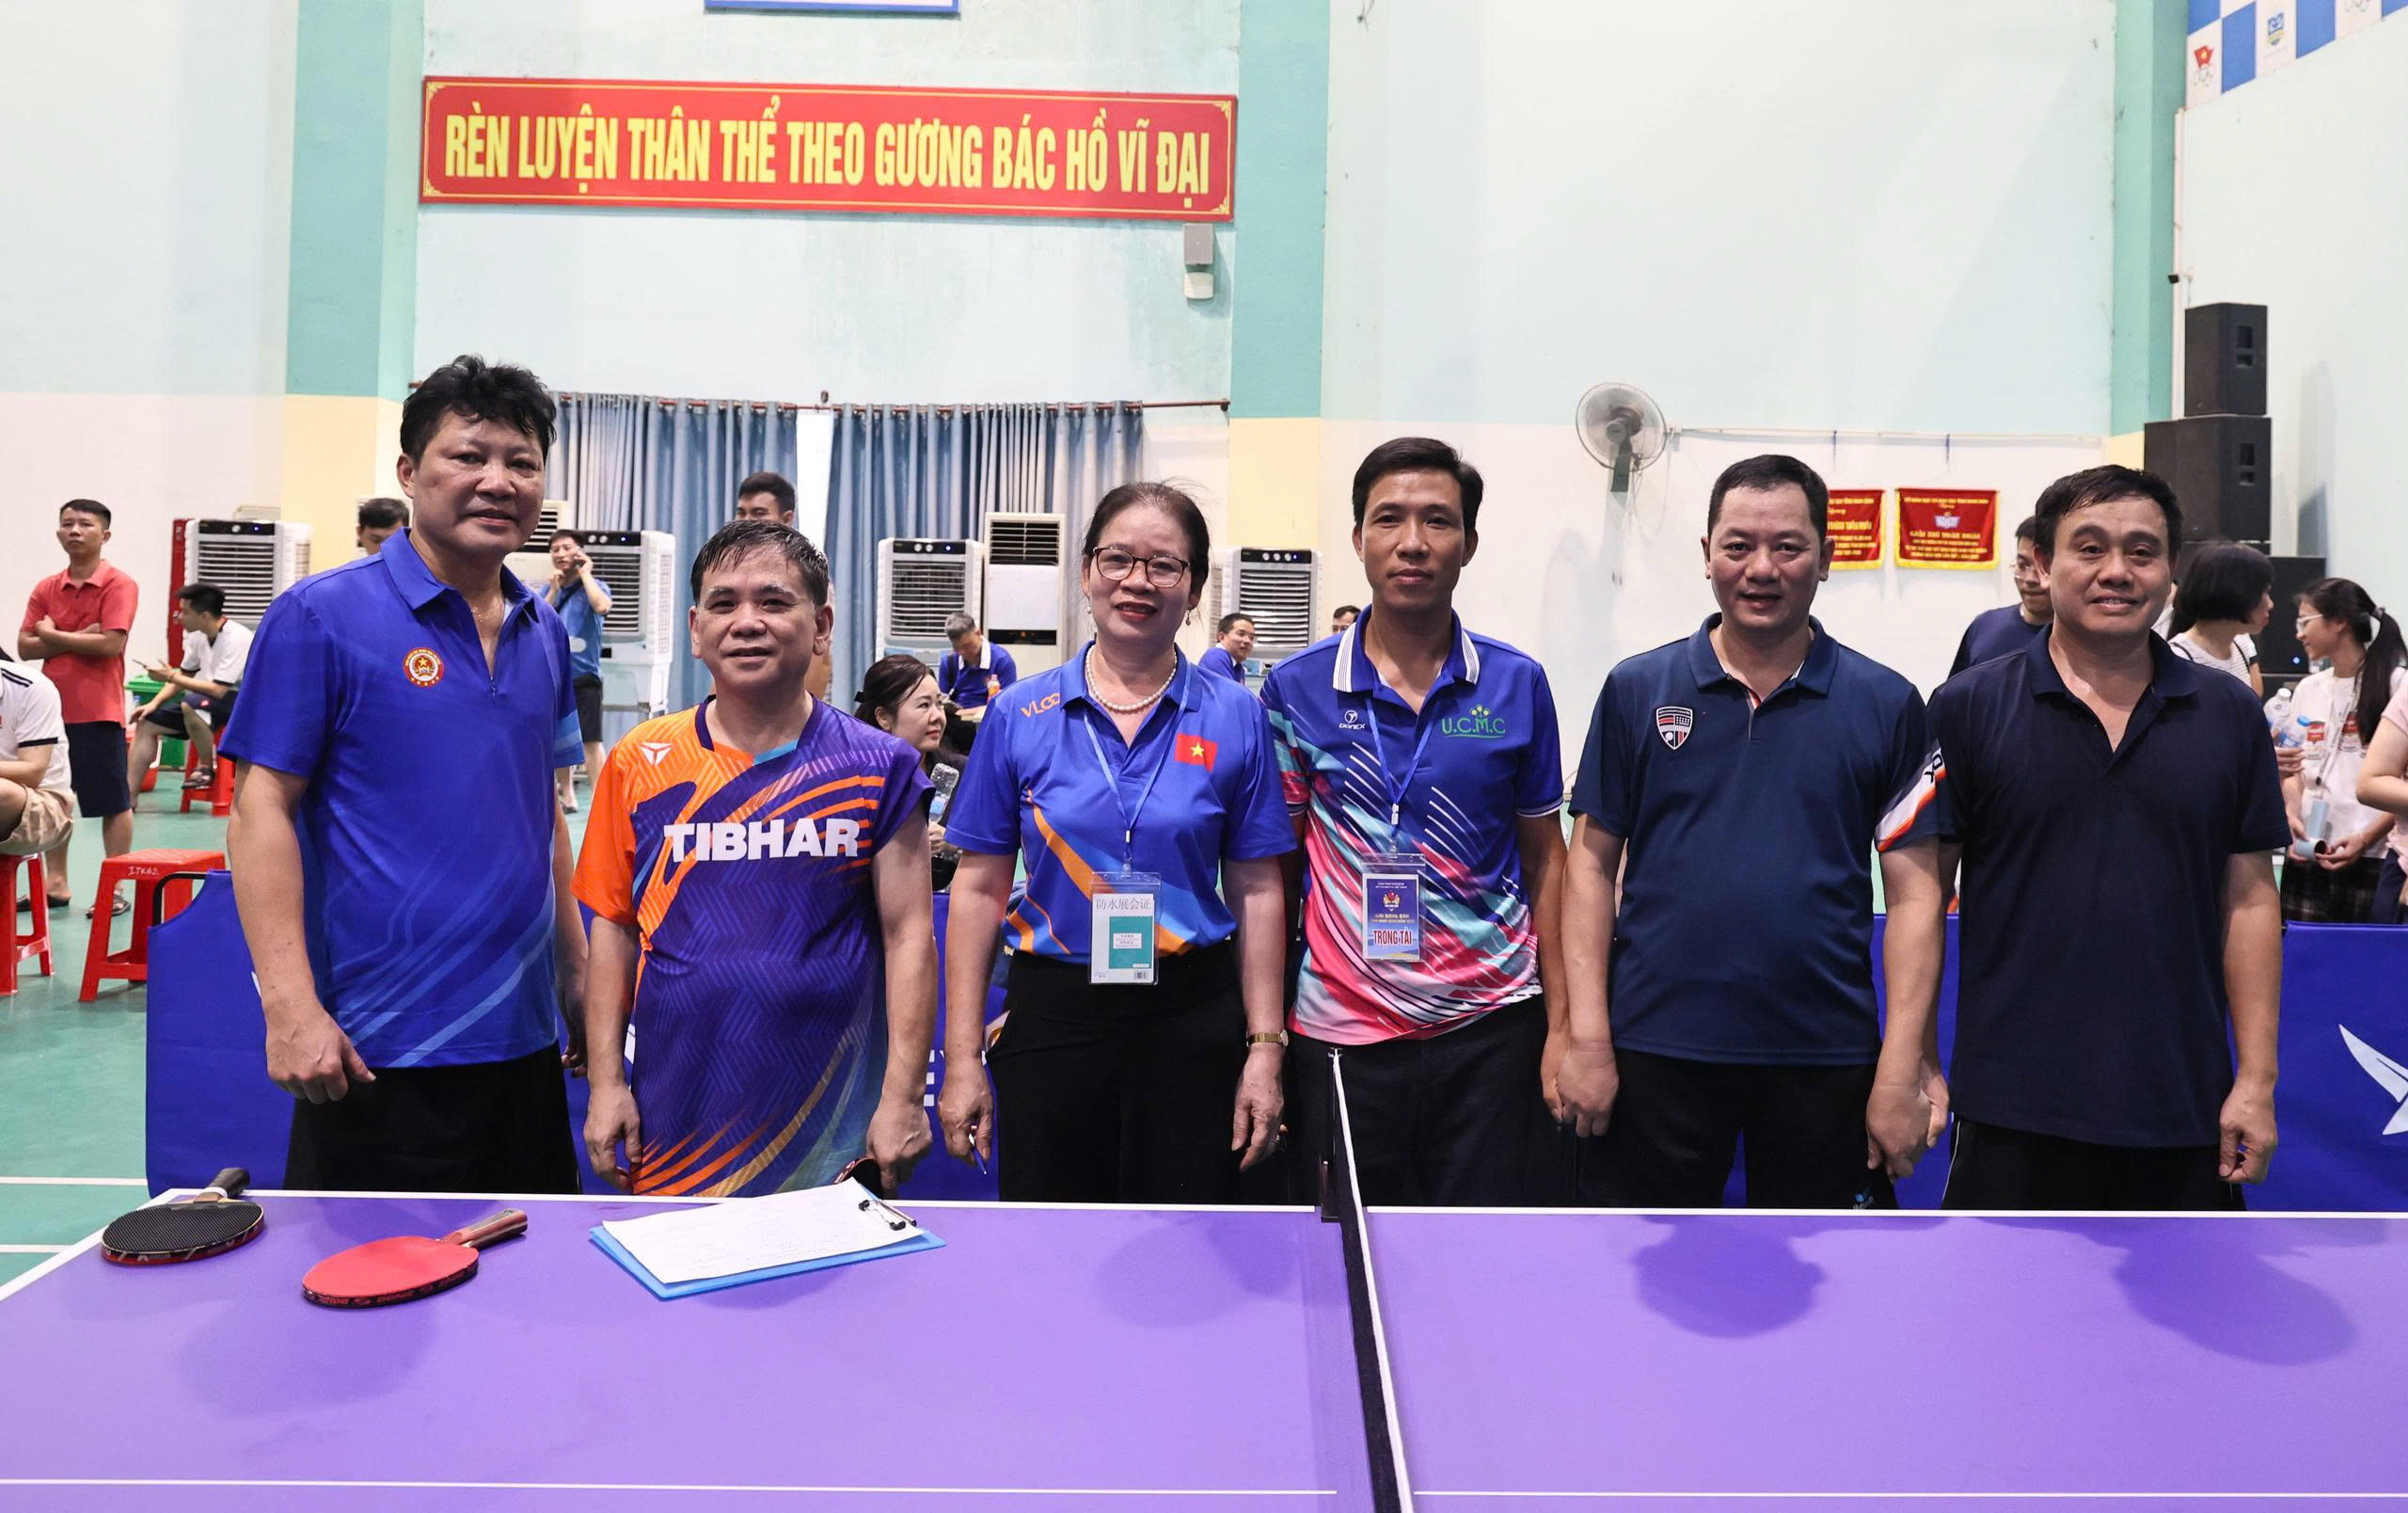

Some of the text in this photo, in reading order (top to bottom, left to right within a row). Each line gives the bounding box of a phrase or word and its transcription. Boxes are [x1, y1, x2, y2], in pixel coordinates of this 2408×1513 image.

[445, 95, 1210, 209] RÈN LUYỆN THÂN THỂ THEO GƯƠNG BÁC HỒ VĨ ĐẠI
[663, 818, 861, 863] TIBHAR
[1373, 930, 1399, 948] TRỌNG
